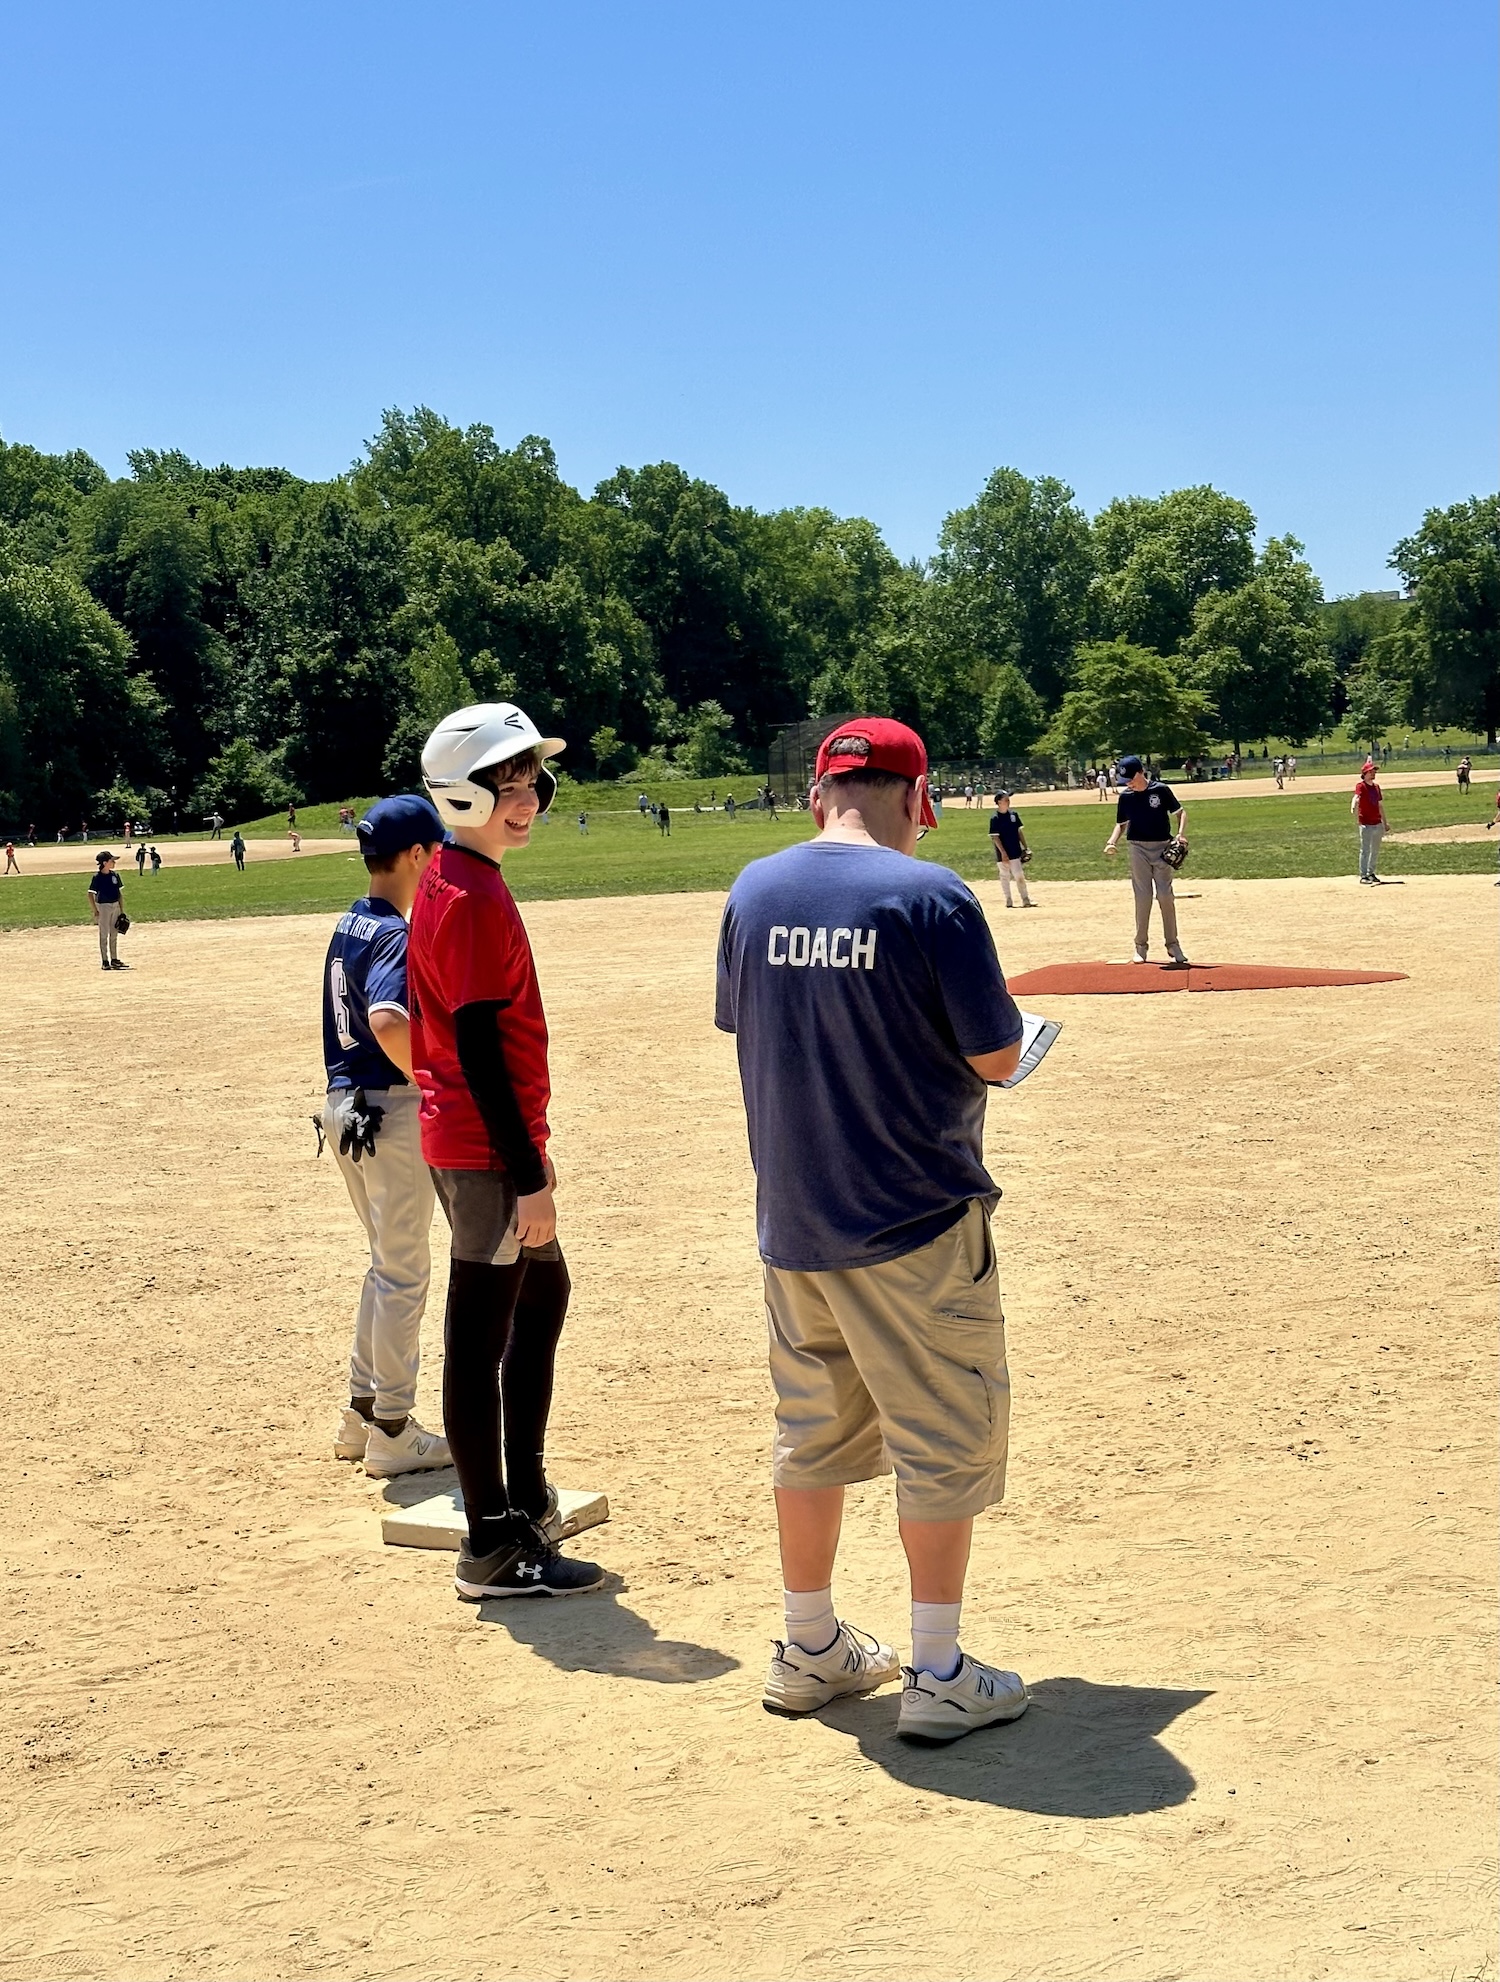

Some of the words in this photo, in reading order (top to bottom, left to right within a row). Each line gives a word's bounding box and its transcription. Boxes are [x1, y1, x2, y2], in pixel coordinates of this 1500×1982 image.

[767, 925, 877, 970] COACH
[331, 957, 360, 1050] 6
[974, 1673, 995, 1700] N
